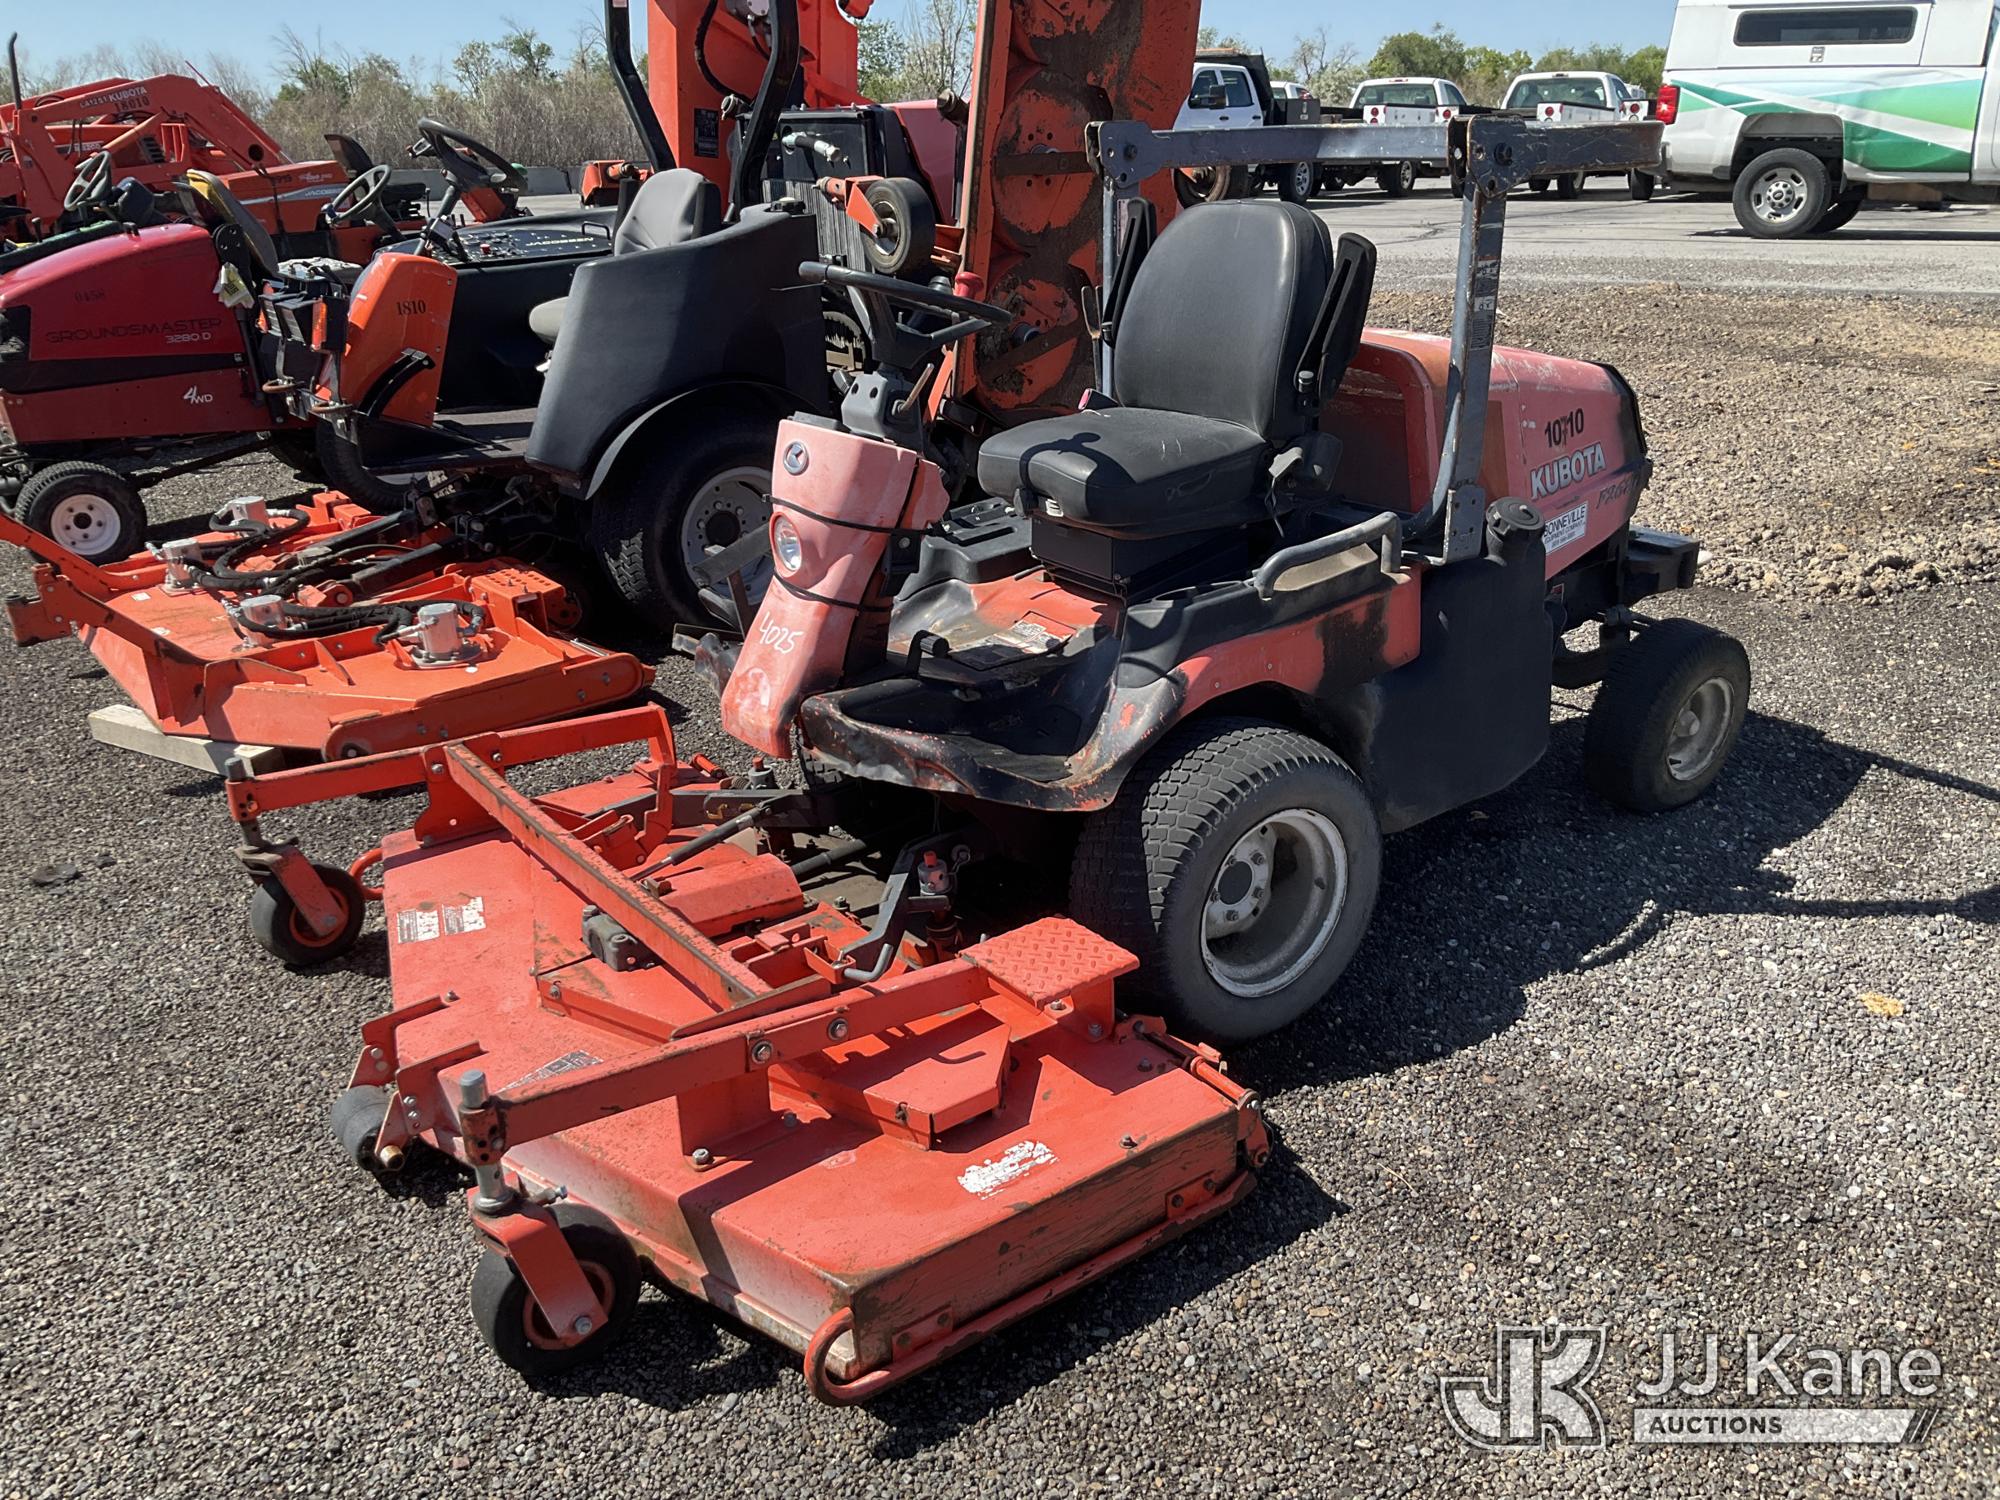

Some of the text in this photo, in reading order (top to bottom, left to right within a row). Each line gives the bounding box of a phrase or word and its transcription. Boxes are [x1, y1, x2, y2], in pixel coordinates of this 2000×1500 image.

[108, 86, 148, 102] KUBOTA
[396, 300, 427, 315] 1810
[45, 318, 222, 344] GROUNDSMASTER
[165, 331, 212, 344] 3280 D
[183, 385, 213, 404] 4WD
[1530, 441, 1607, 500] KUBOTA
[759, 610, 805, 654] 4025
